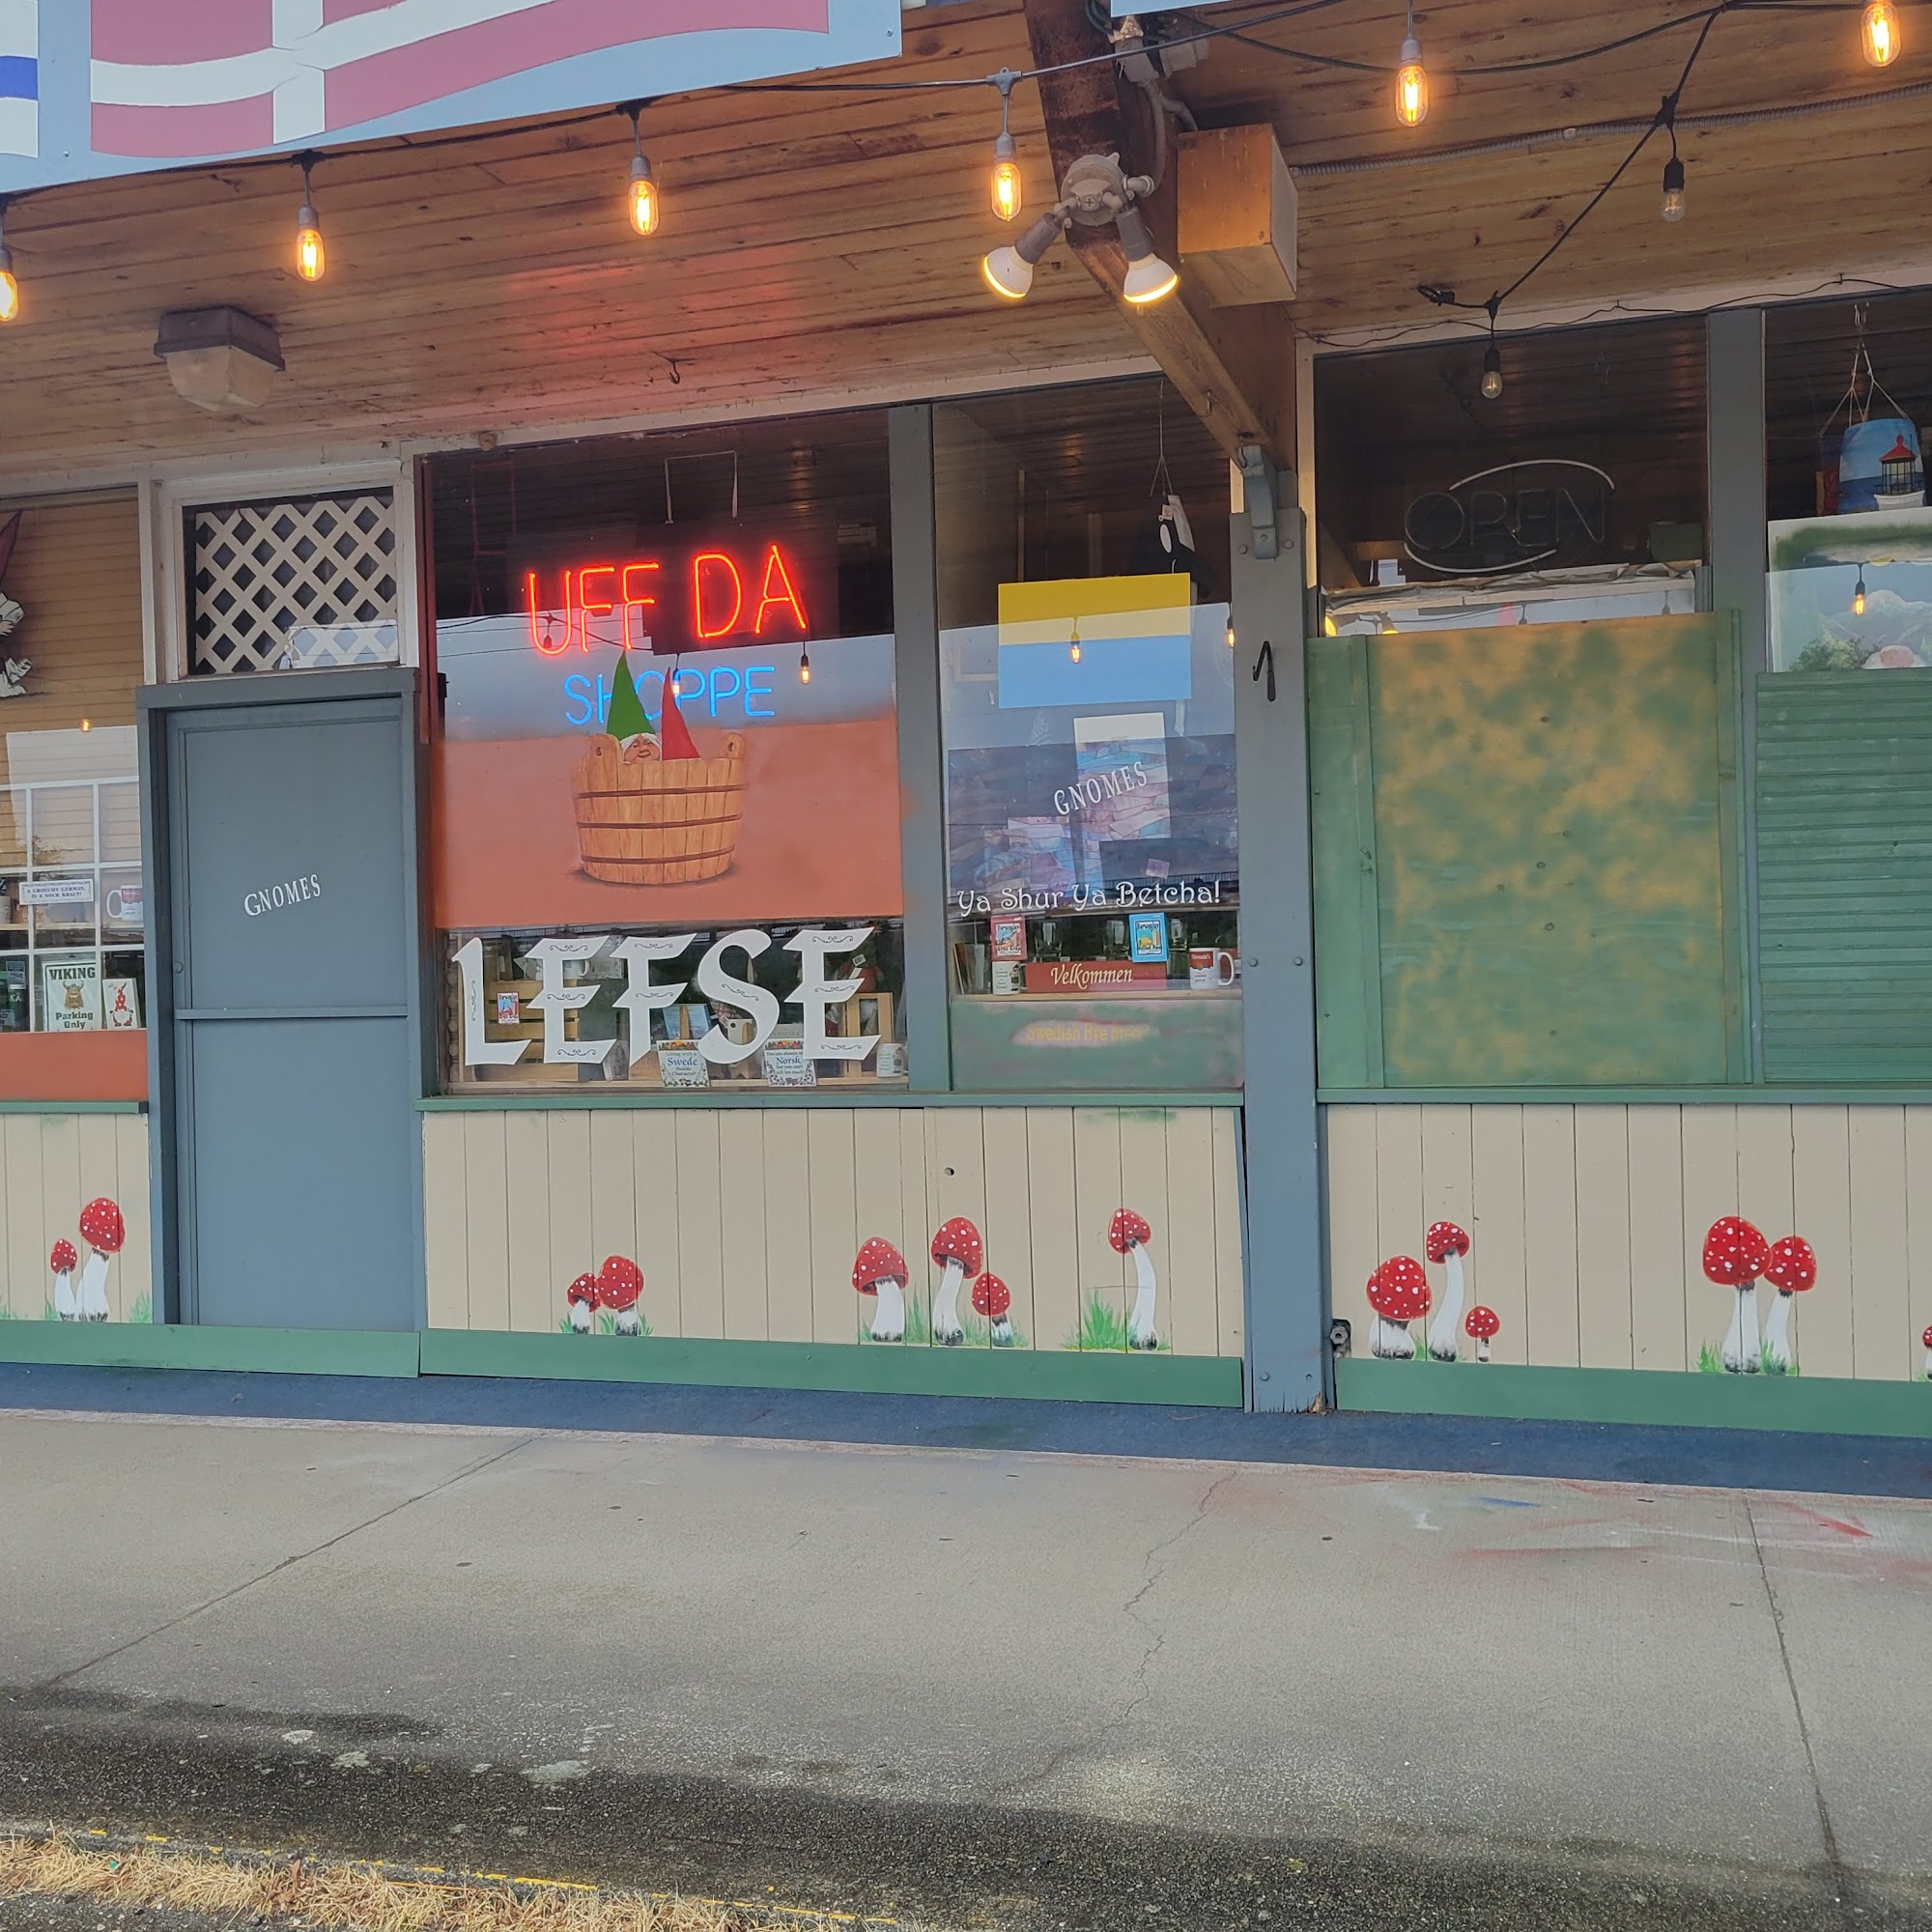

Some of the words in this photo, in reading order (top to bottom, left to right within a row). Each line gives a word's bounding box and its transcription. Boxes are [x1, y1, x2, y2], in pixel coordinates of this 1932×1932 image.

[1405, 487, 1605, 551] OPEN
[527, 562, 660, 656] UFF
[694, 544, 808, 639] DA
[1053, 760, 1149, 817] GNOMES
[243, 873, 322, 917] GNOMES
[957, 890, 991, 917] Ya
[1001, 888, 1065, 912] Shur
[1072, 884, 1106, 911] Ya
[1116, 880, 1220, 907] Betcha!
[48, 967, 96, 980] VIKING
[1050, 963, 1133, 990] Velkommen
[451, 926, 882, 1066] LEFSE
[55, 1011, 94, 1021] Parking
[64, 1020, 86, 1030] Only
[668, 1056, 697, 1066] Swede
